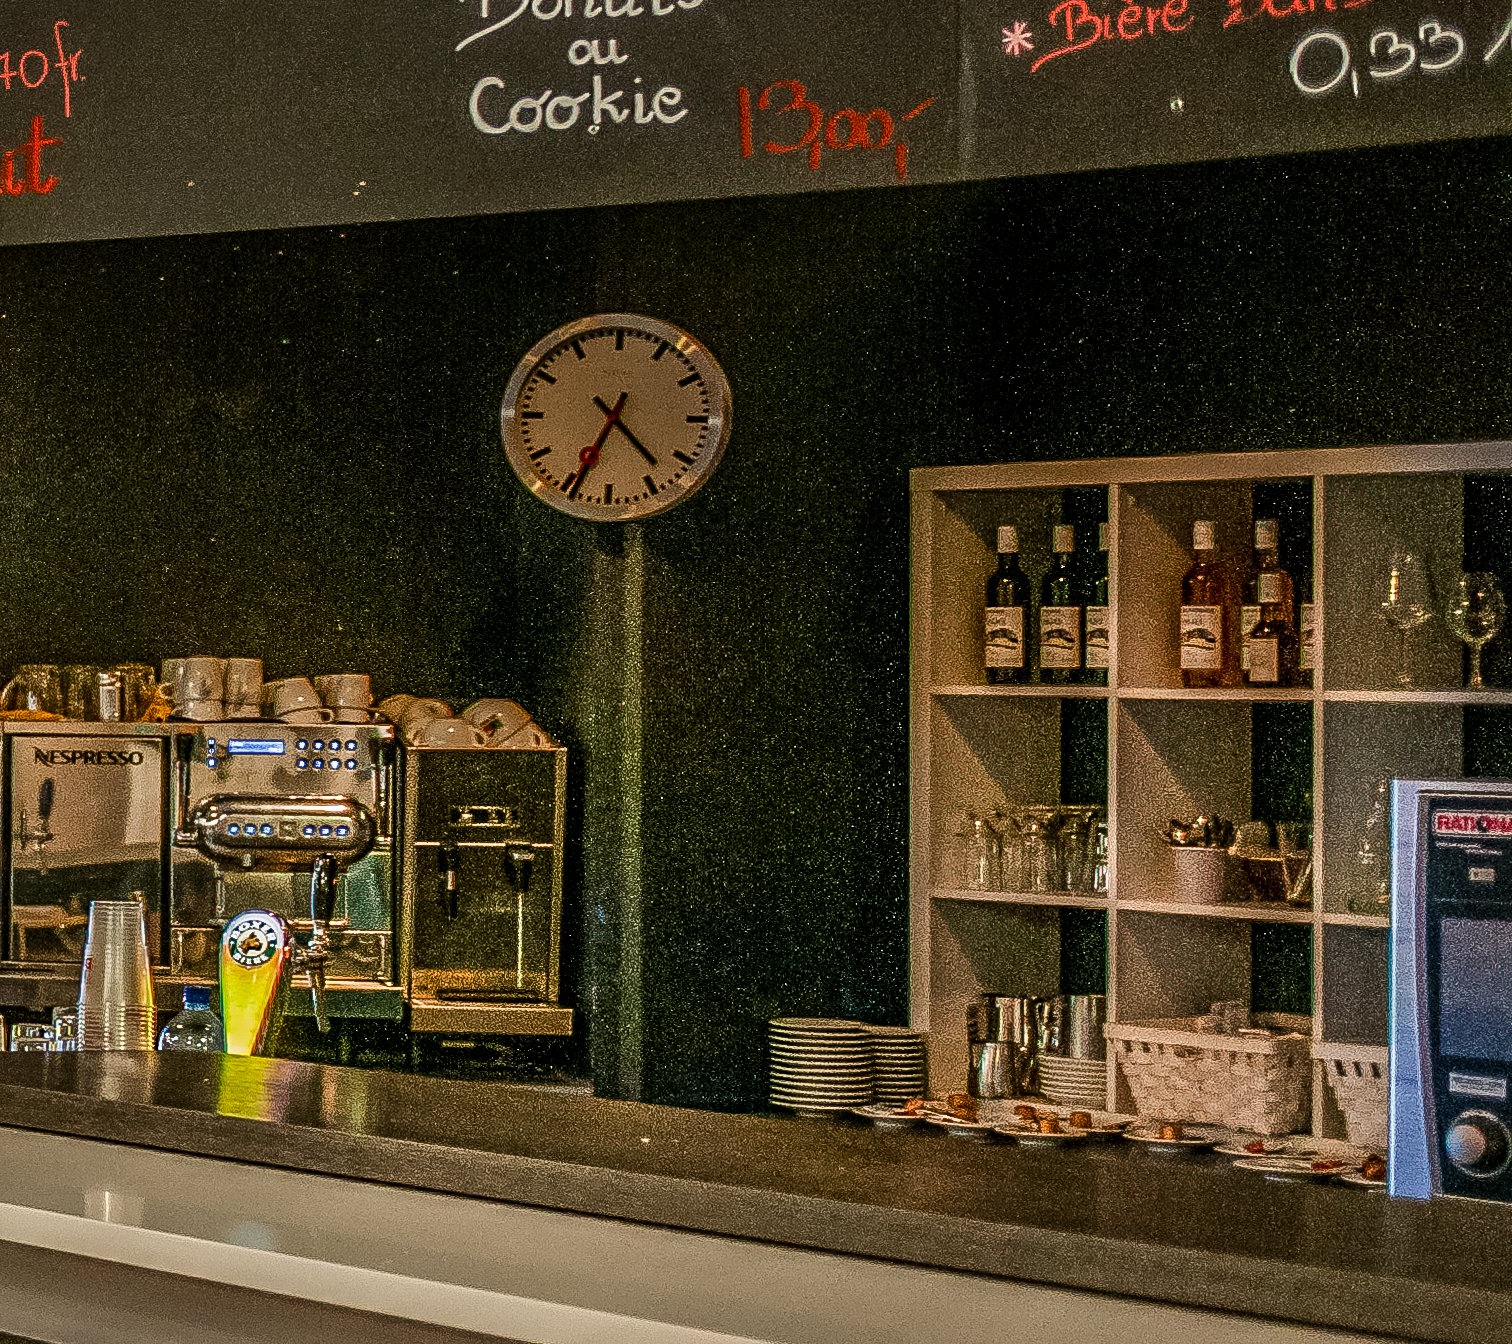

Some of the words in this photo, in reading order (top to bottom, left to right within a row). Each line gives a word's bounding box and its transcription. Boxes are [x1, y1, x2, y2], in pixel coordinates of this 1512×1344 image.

[567, 36, 628, 64] ou
[1289, 18, 1465, 99] 0,33
[468, 74, 689, 136] Cookie
[33, 745, 144, 768] NESPRESSO
